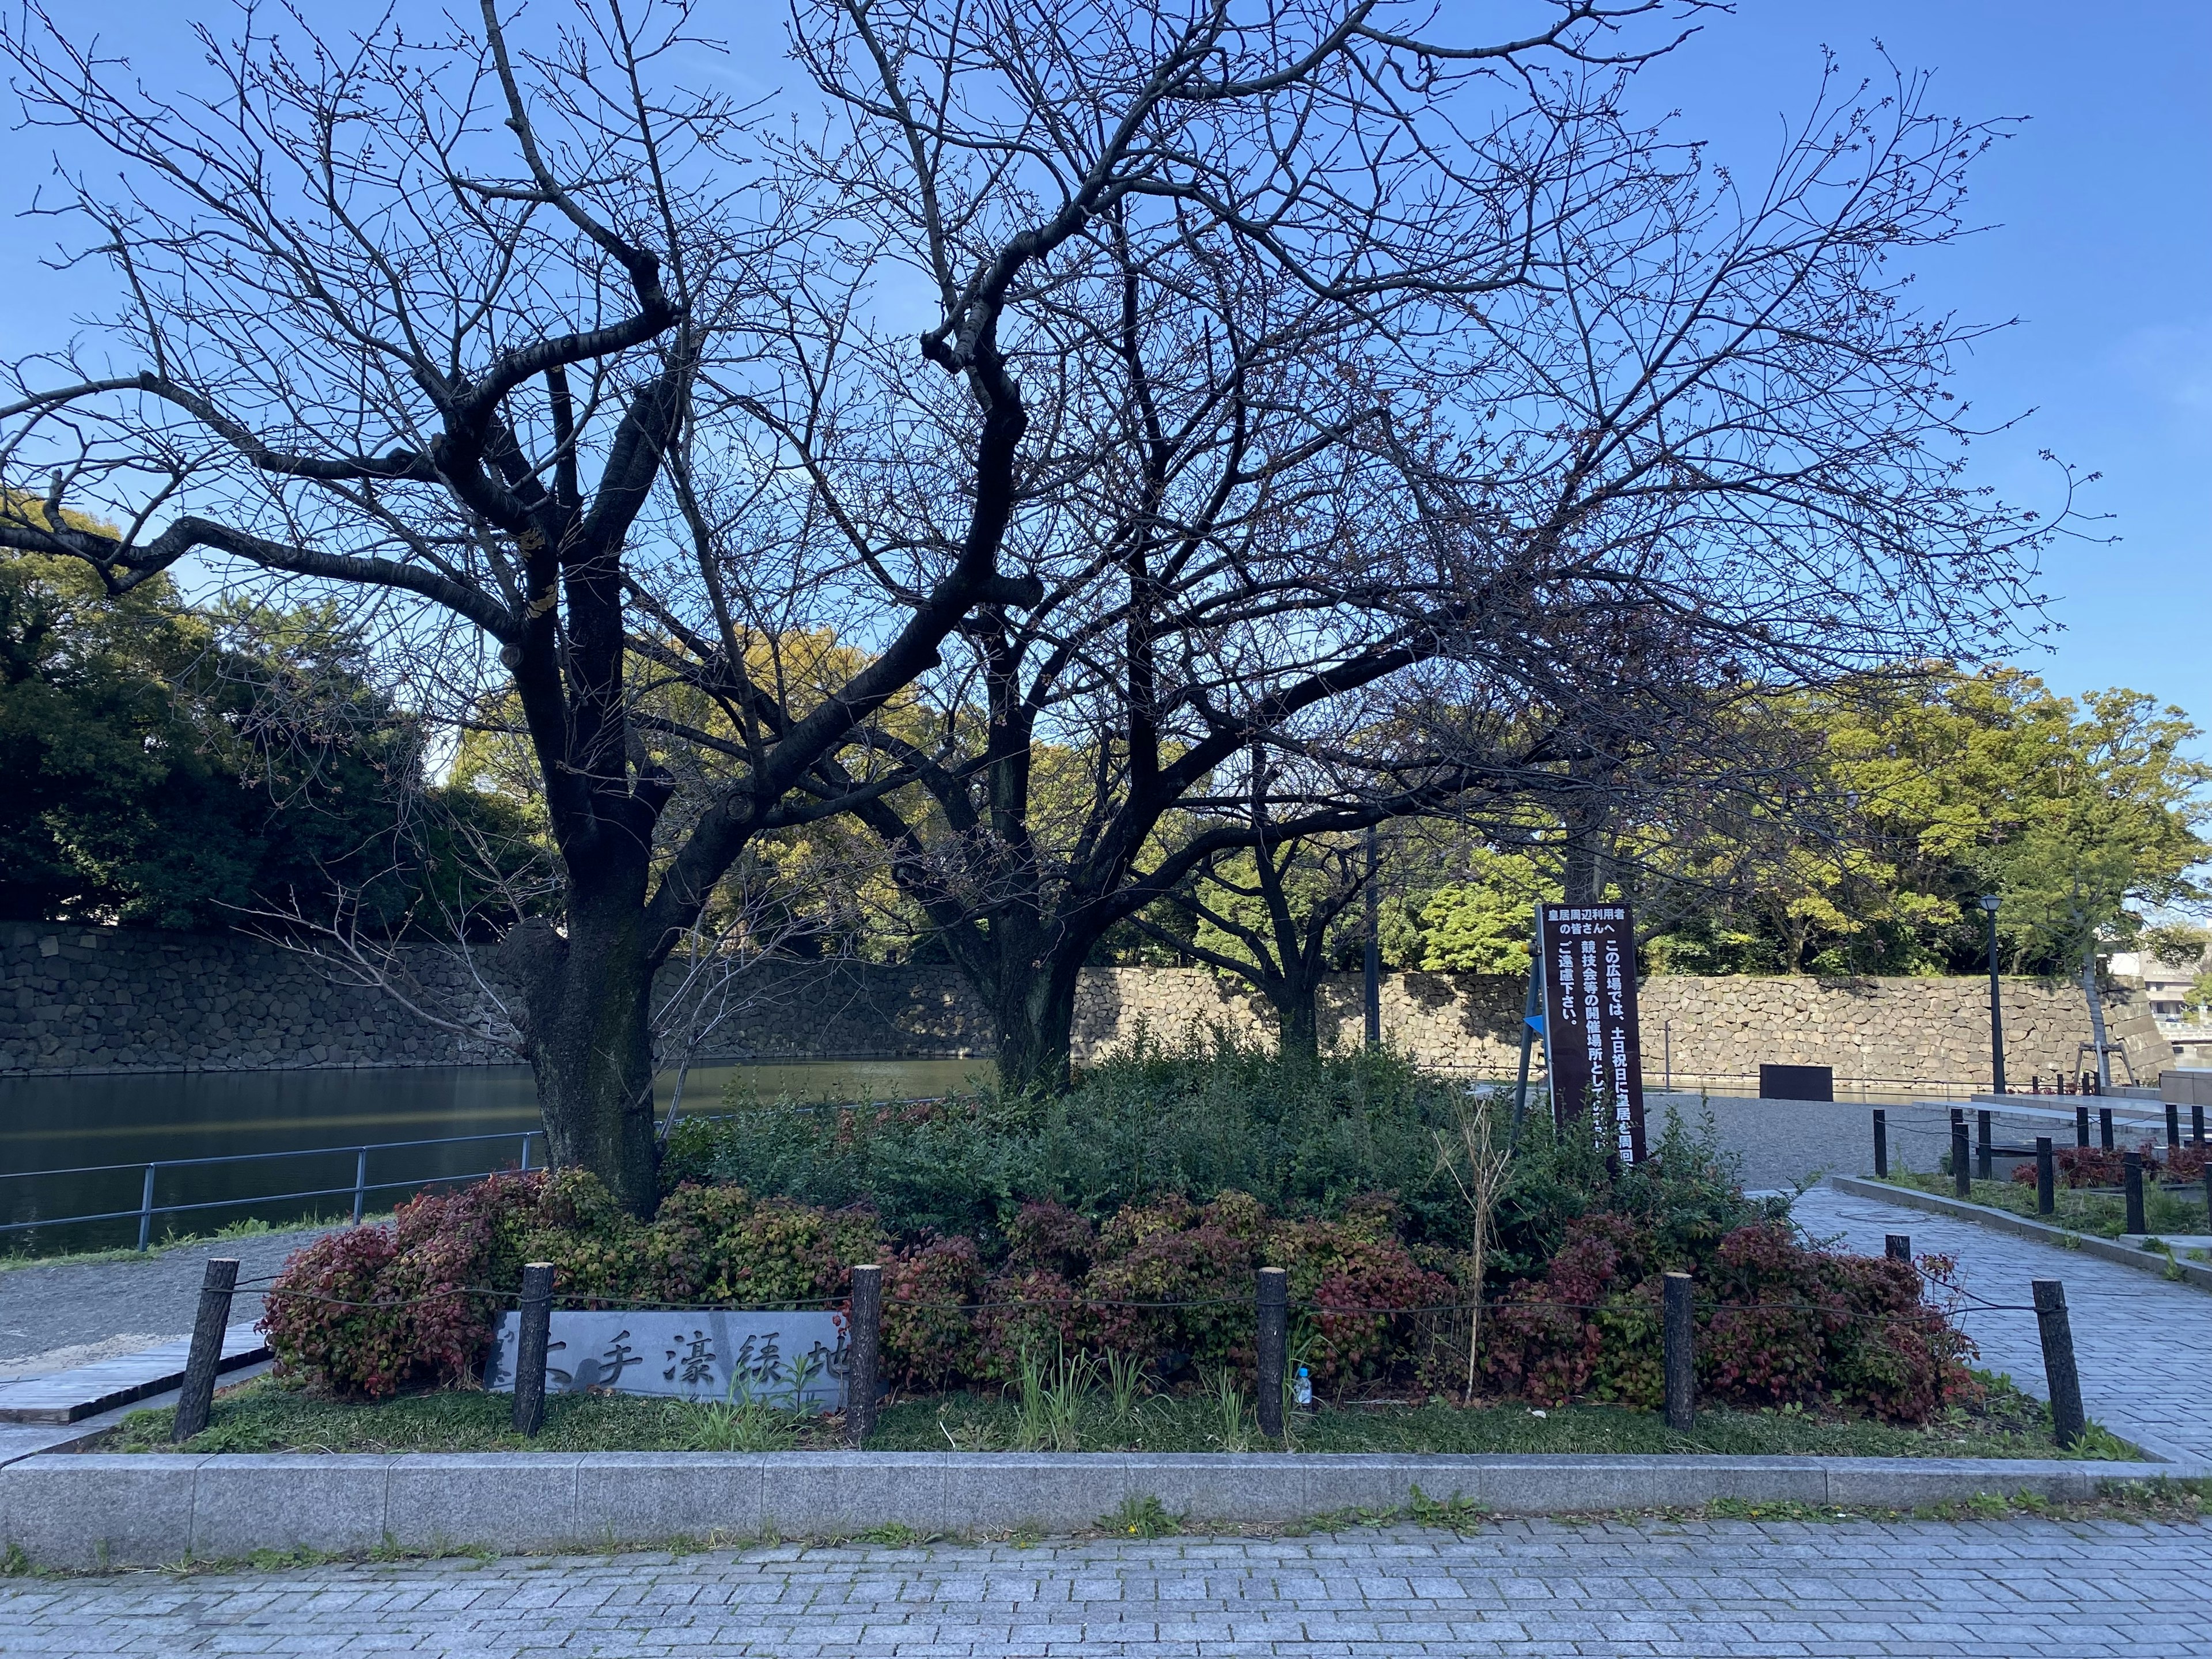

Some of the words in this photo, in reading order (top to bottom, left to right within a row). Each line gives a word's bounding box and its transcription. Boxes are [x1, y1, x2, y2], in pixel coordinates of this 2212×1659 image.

[1547, 908, 1625, 922] 皇居周辺利用者
[1559, 923, 1615, 935] の皆さんへ
[1558, 940, 1577, 1025] ご遠慮下さい。
[1605, 940, 1634, 1171] この広場では、土日祝日に皇居を周回
